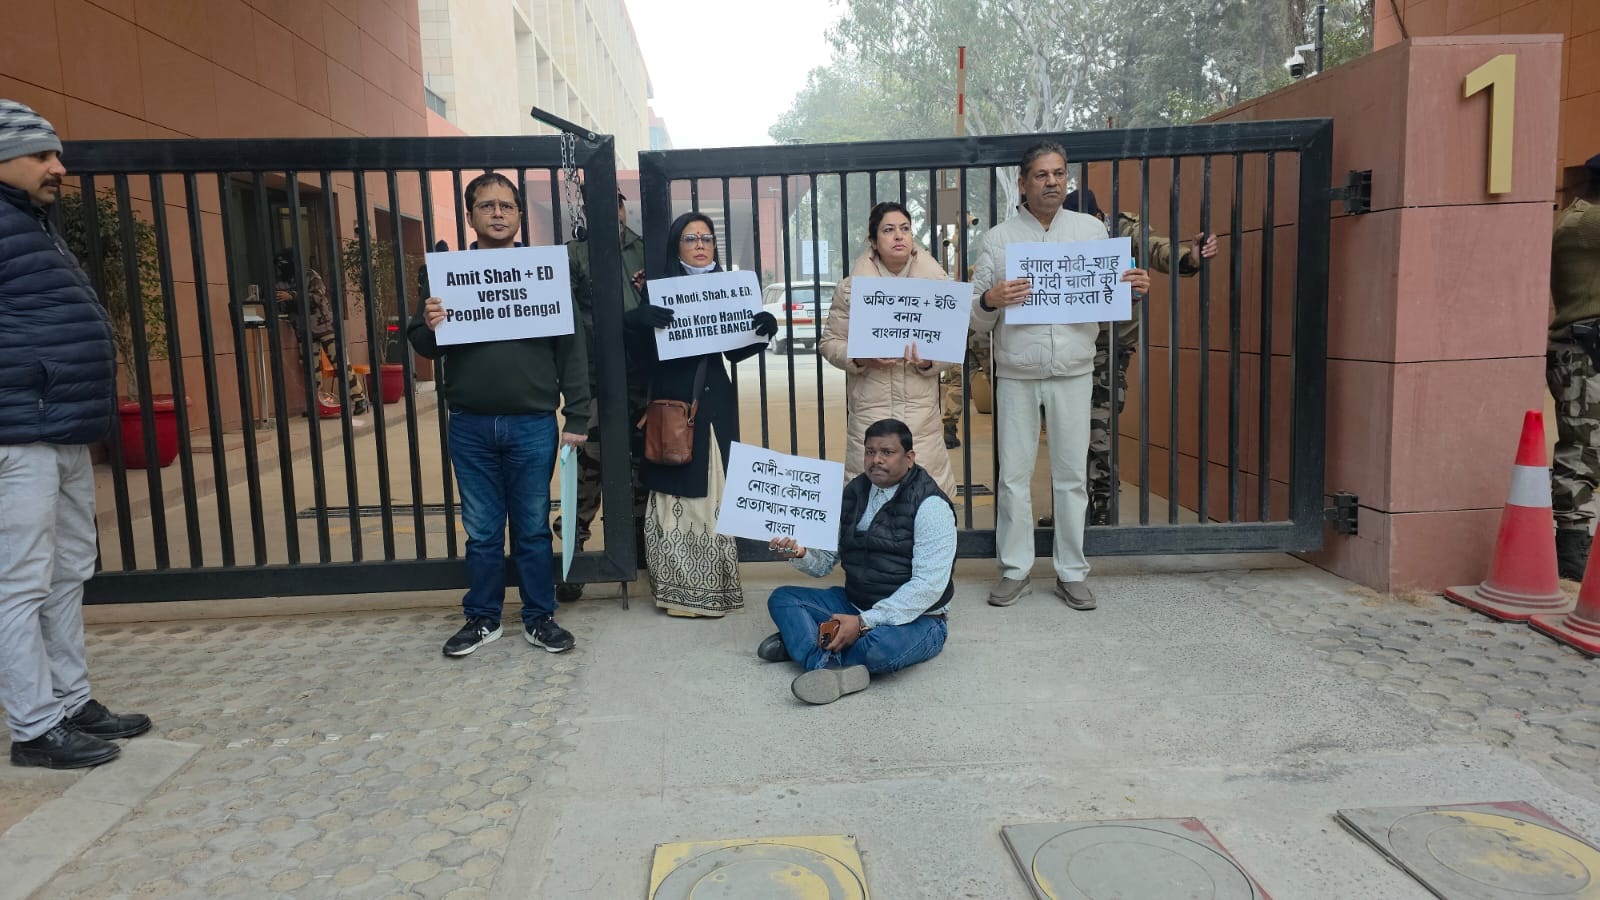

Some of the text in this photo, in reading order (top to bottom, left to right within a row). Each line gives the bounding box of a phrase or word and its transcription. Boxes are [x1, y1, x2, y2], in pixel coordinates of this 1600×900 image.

[1462, 54, 1516, 194] 1
[1019, 257, 1053, 272] बंगाल
[446, 265, 554, 286] Amit Shah + ED
[1038, 272, 1062, 289] गंदी
[1065, 270, 1096, 288] चालों
[1098, 268, 1118, 287] को
[477, 287, 528, 302] versus
[661, 295, 674, 306] To
[676, 291, 701, 305] Modi,
[731, 288, 738, 298] &
[863, 290, 958, 309] অমিত শাহ + ইডি
[1064, 291, 1100, 305] करता
[1103, 285, 1114, 305] है
[446, 301, 560, 323] People of Bengal
[693, 314, 717, 326] Koro
[719, 309, 754, 323] Hamla
[893, 311, 922, 323] বনাম
[668, 328, 694, 341] ABAR
[695, 325, 719, 338] JITBE
[872, 328, 942, 343] বাংলার মানুষ
[748, 479, 821, 502] নোংরা কৌশল
[736, 496, 828, 522] প্রত্যাখ্যান করেছে
[765, 520, 795, 536] বাংলা
